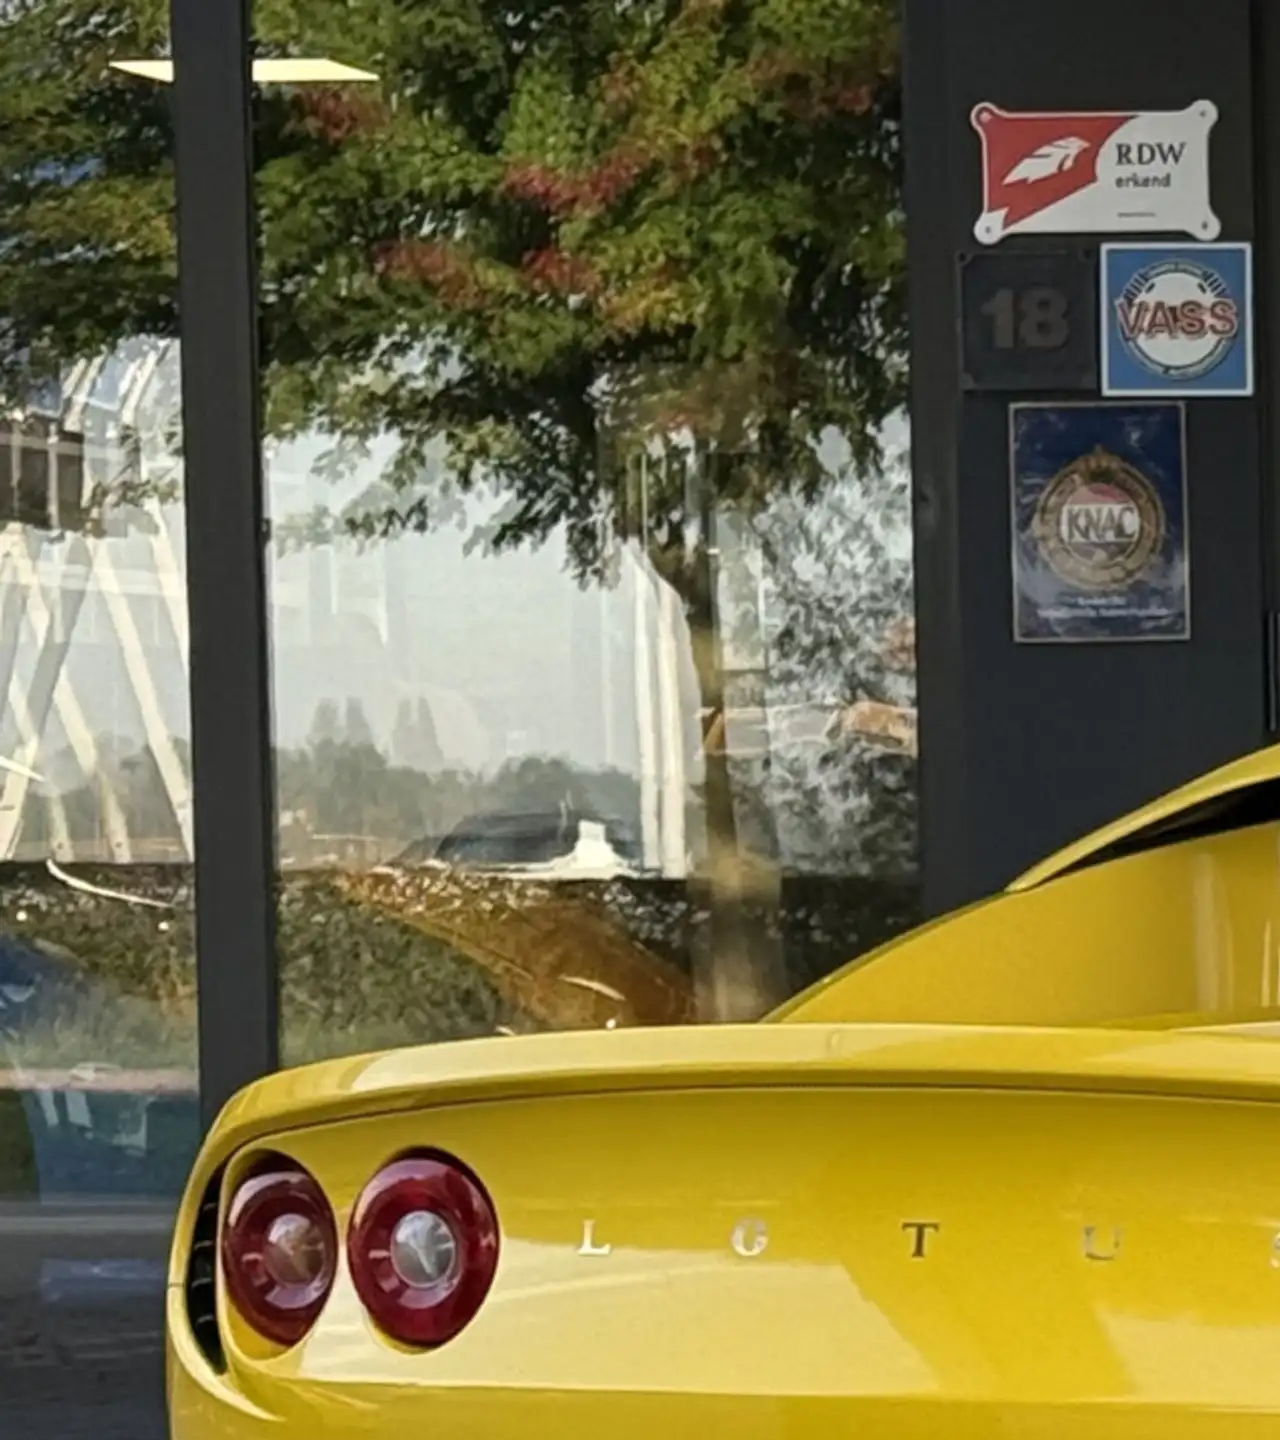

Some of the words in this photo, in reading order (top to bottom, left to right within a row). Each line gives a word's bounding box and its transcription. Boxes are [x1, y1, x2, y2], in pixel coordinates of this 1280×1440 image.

[1115, 142, 1187, 166] RDW
[1115, 172, 1171, 188] erkend
[980, 288, 1070, 348] 18
[1115, 299, 1237, 336] VASS
[1066, 505, 1137, 541] KNAC
